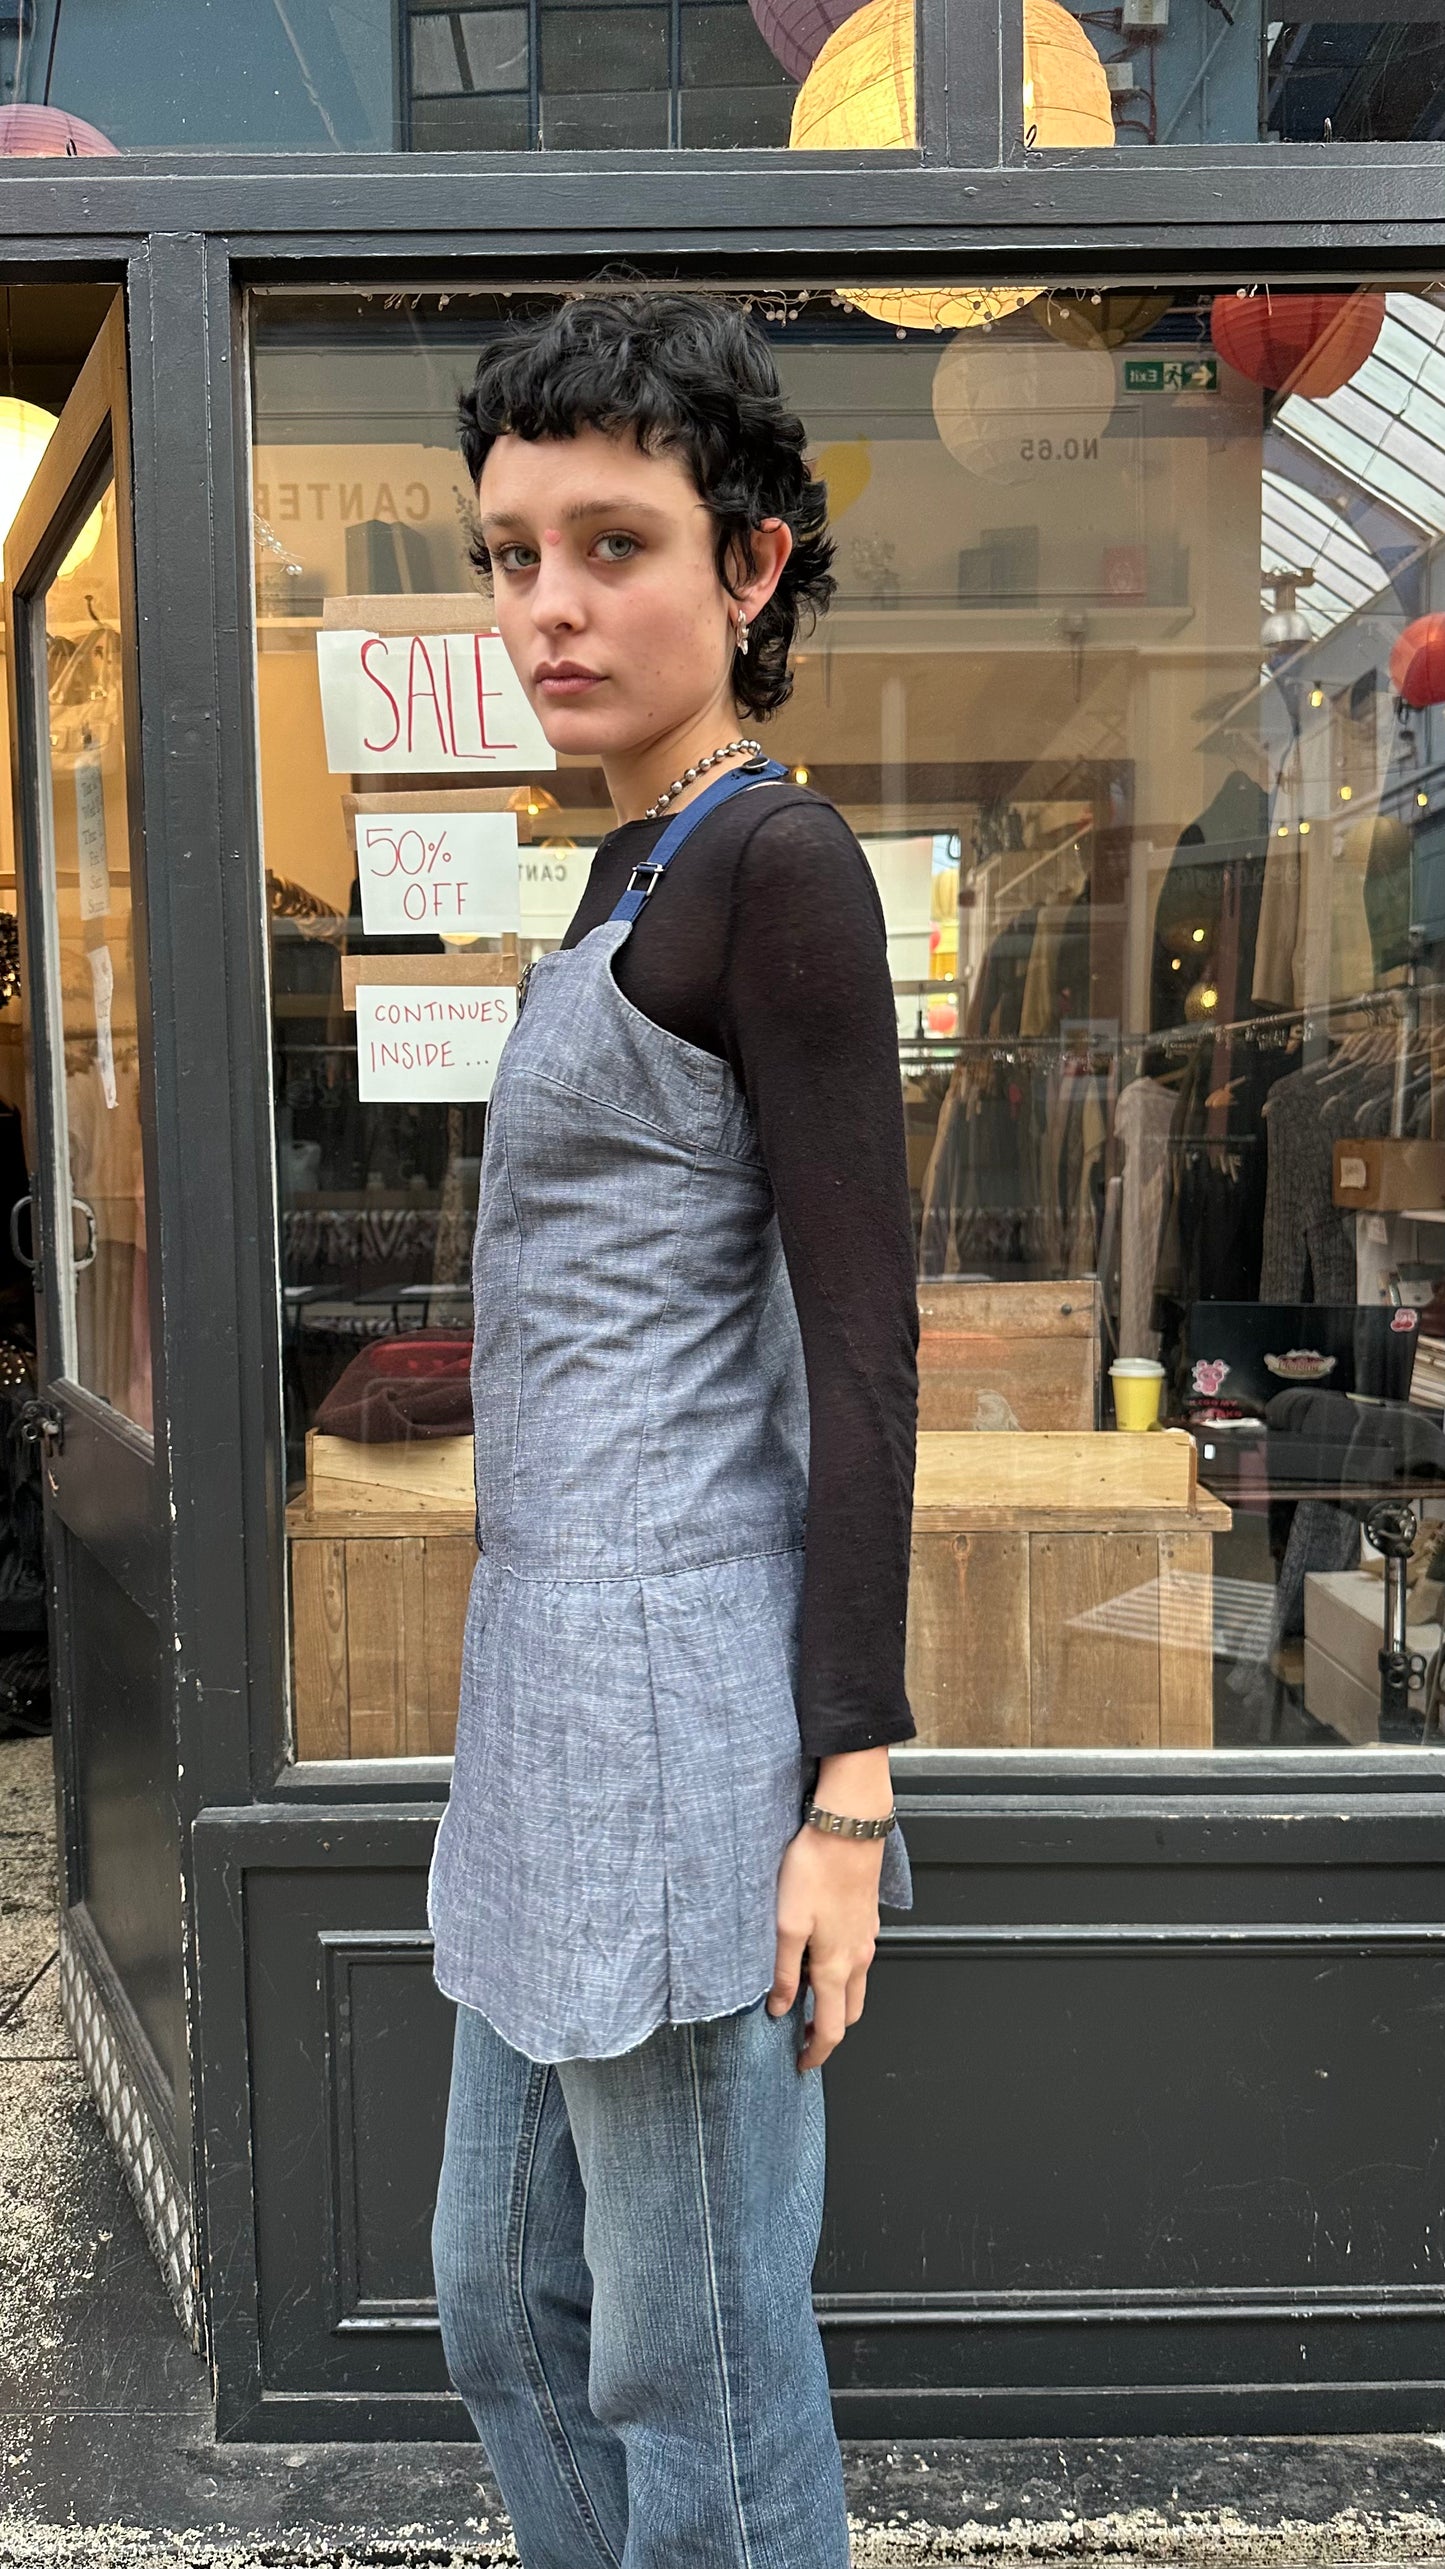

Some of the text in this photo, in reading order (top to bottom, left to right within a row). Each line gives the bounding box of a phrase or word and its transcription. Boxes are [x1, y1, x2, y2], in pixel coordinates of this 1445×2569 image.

[360, 632, 518, 759] SALE
[365, 827, 453, 877] 50%
[402, 882, 469, 921] OFF
[374, 999, 509, 1024] CONTINUES
